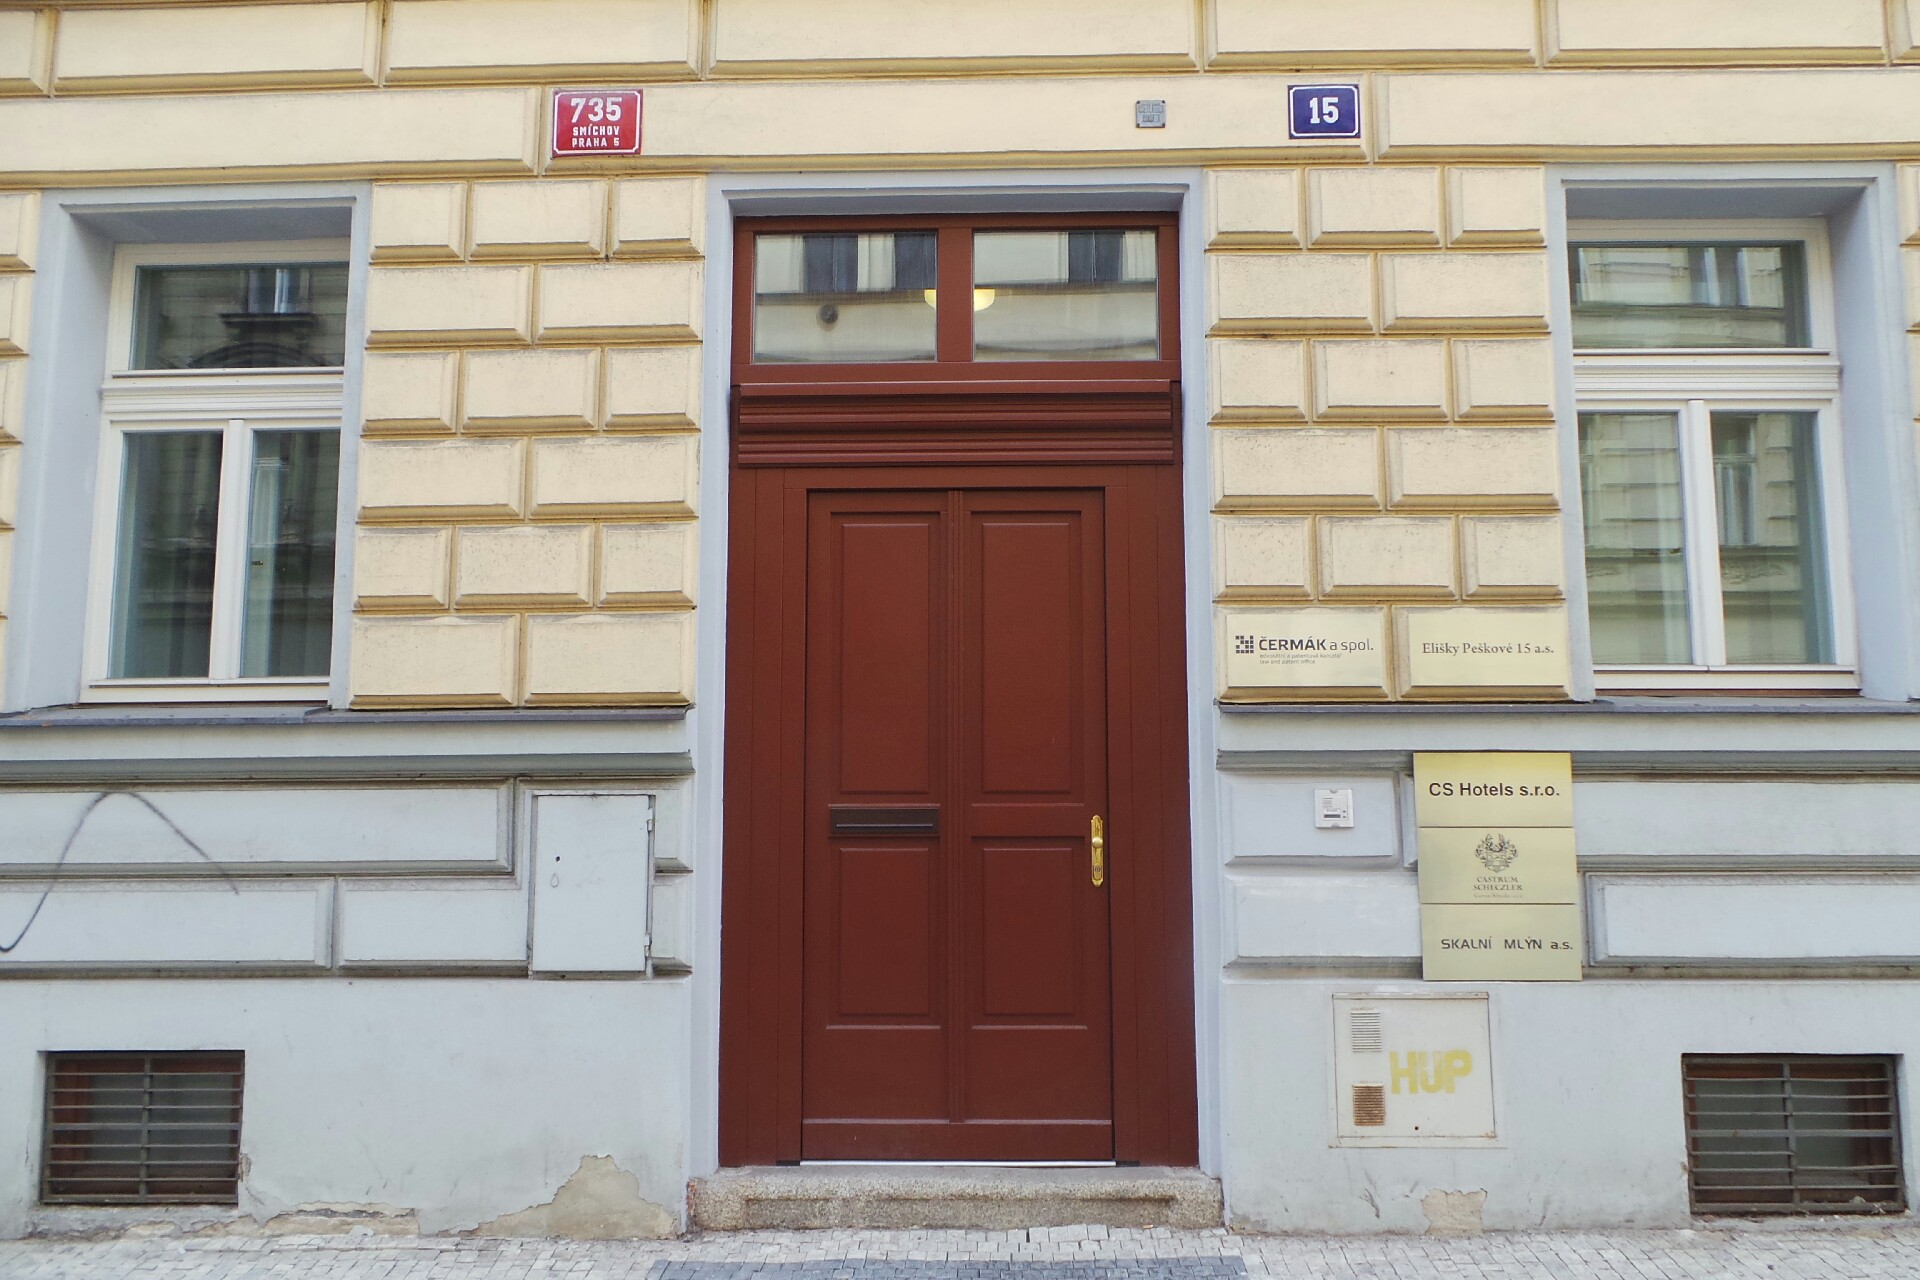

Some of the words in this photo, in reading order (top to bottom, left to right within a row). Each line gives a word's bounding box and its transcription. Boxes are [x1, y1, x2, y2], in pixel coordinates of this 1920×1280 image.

[570, 97, 622, 123] 735
[1309, 97, 1339, 123] 15
[572, 124, 620, 136] SMÍCHOV
[571, 137, 607, 148] PRAHA
[613, 137, 620, 147] 5
[1258, 636, 1327, 651] ČERMÁK
[1329, 641, 1337, 651] a
[1340, 638, 1374, 653] spol.
[1421, 642, 1459, 656] Elišky
[1462, 642, 1513, 654] Peškové
[1517, 643, 1531, 654] 15
[1534, 645, 1554, 654] a.s.
[1429, 783, 1454, 796] CS
[1460, 783, 1514, 796] Hotels
[1519, 785, 1560, 796] s.r.o.
[1441, 936, 1492, 949] SKALNÍ
[1504, 936, 1542, 949] MLÝN
[1550, 941, 1574, 949] a.s.
[1389, 1049, 1473, 1095] HUP
